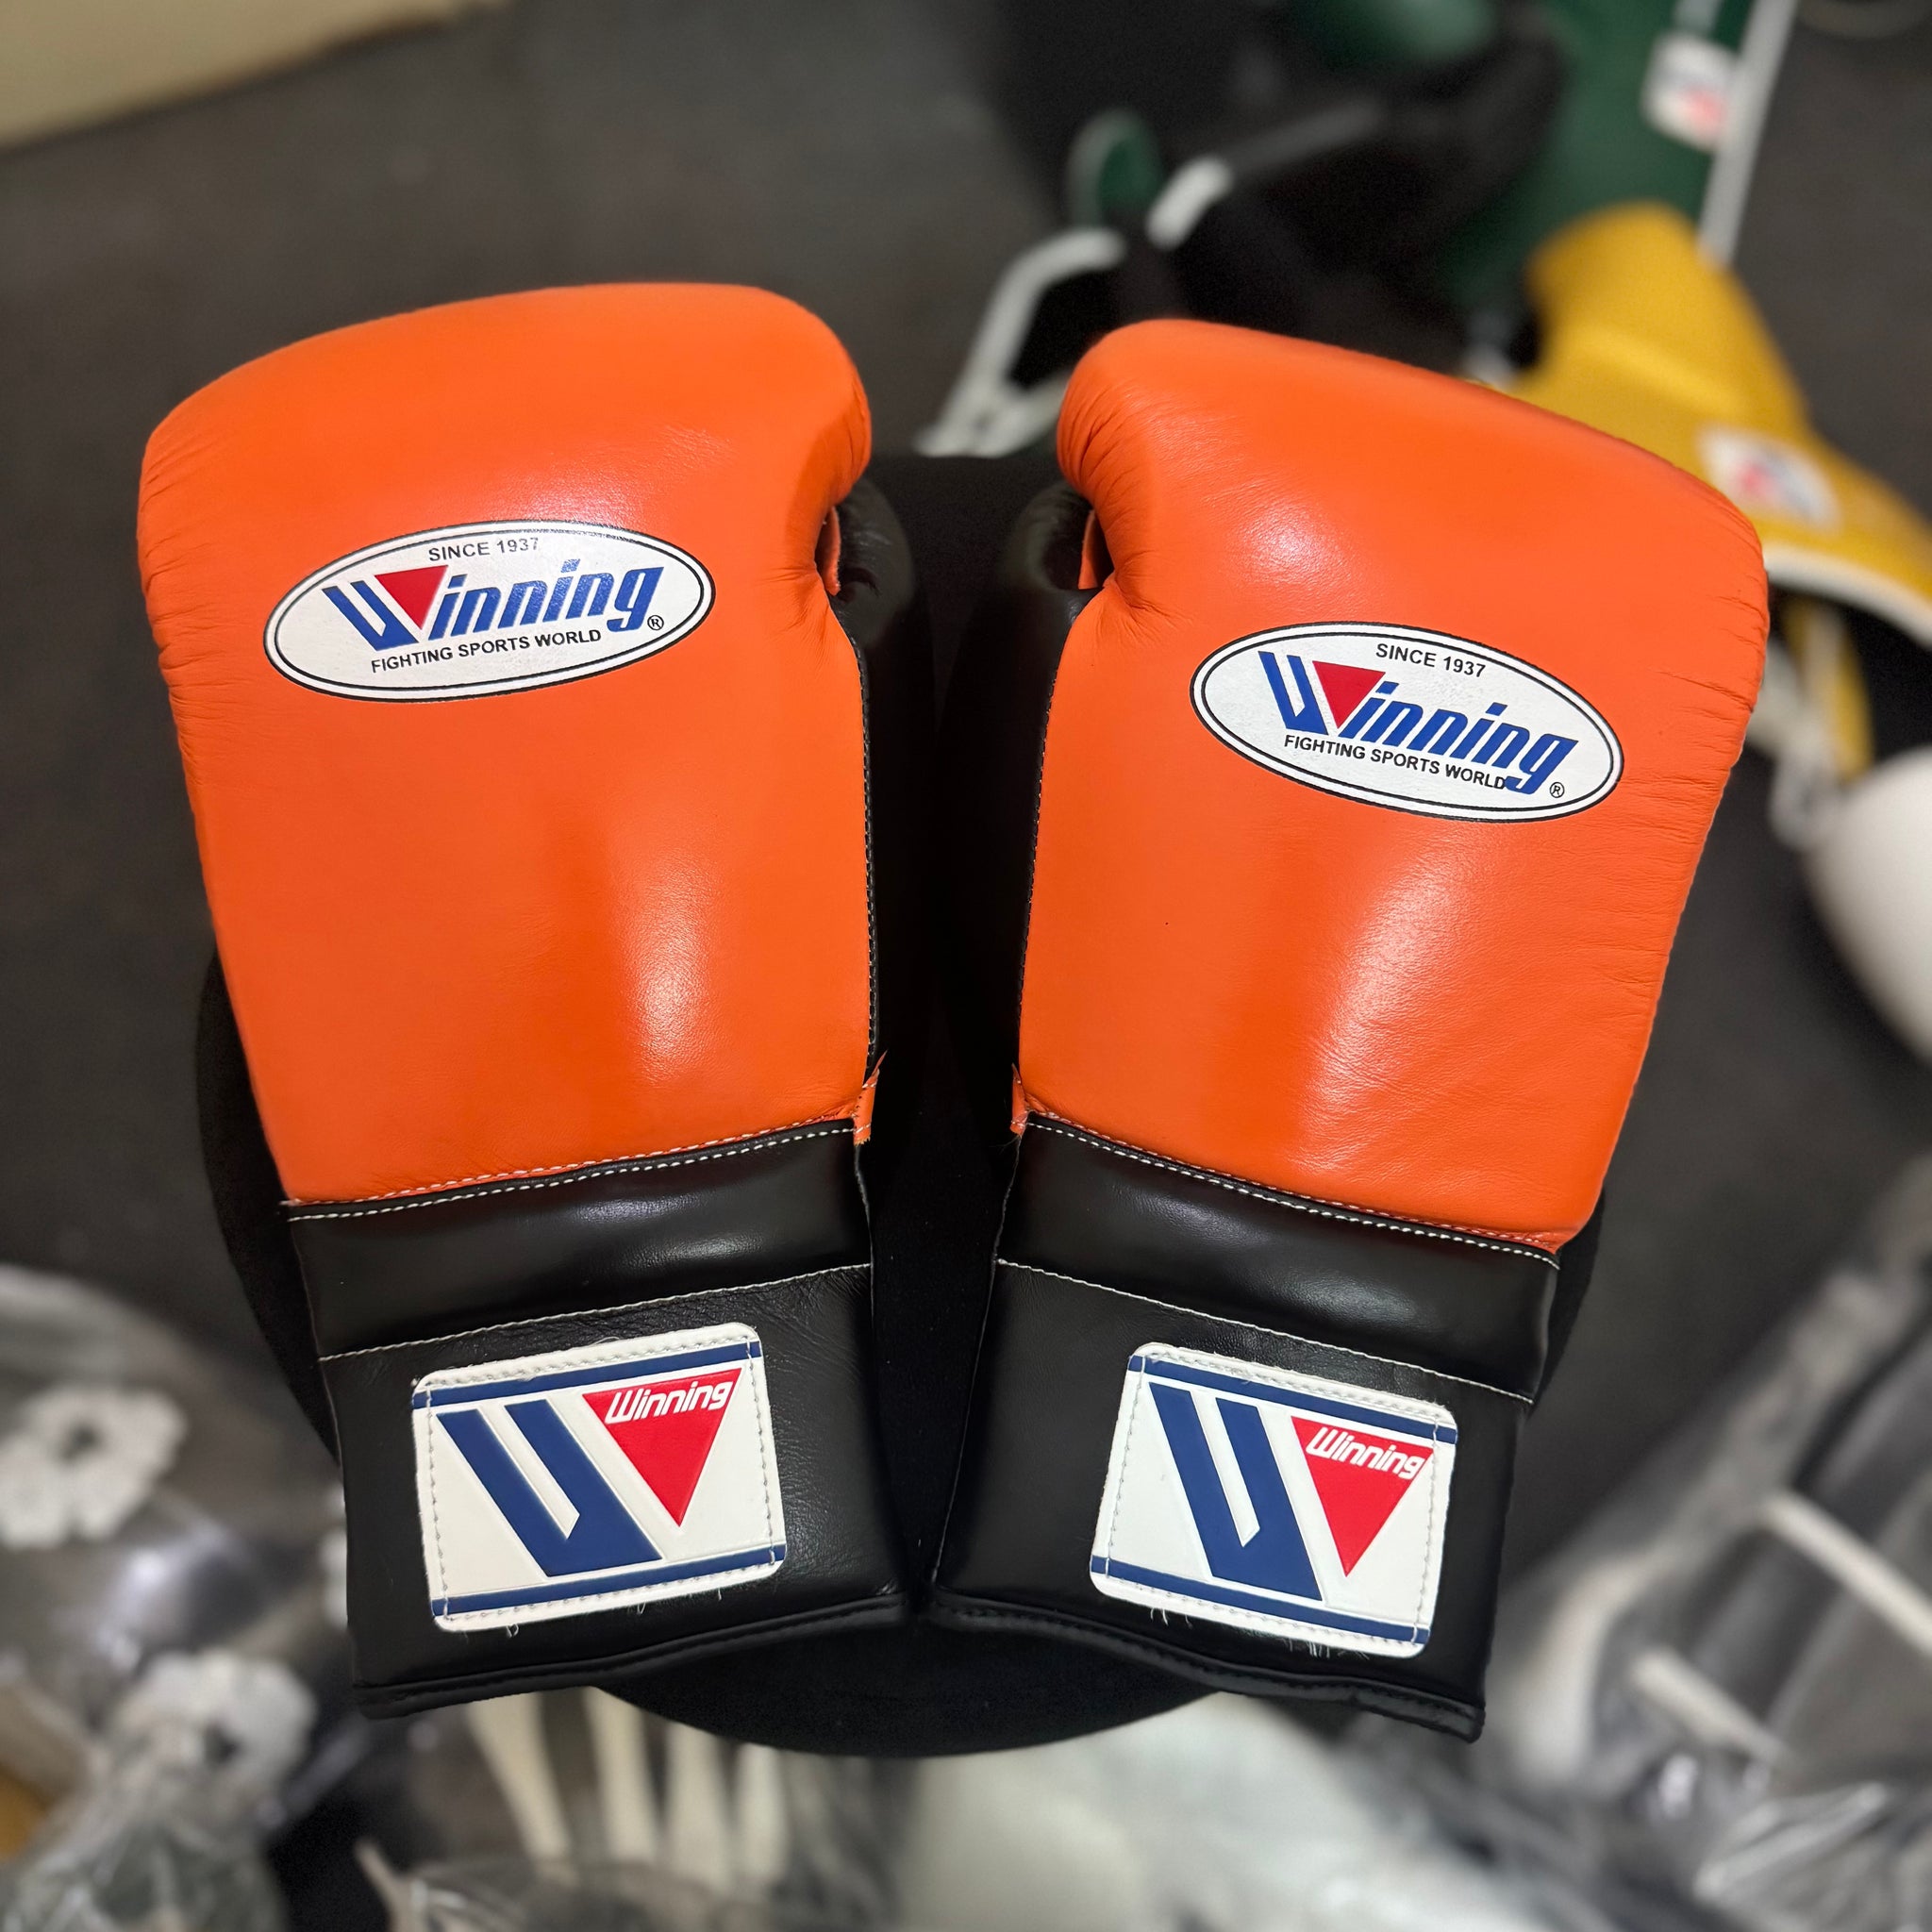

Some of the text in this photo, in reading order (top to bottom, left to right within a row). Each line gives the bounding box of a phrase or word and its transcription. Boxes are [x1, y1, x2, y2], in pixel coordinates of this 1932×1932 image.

[428, 537, 540, 561] SINCE 1937
[323, 558, 664, 651] Winning
[371, 629, 602, 674] FIGHTING SPORTS WORLD
[1375, 643, 1487, 678] SINCE 1937
[1257, 650, 1578, 795] Winning
[1284, 734, 1507, 791] FIGHTING SPORTS WORLD
[604, 1381, 733, 1424] Winning
[1306, 1426, 1424, 1480] Winning
